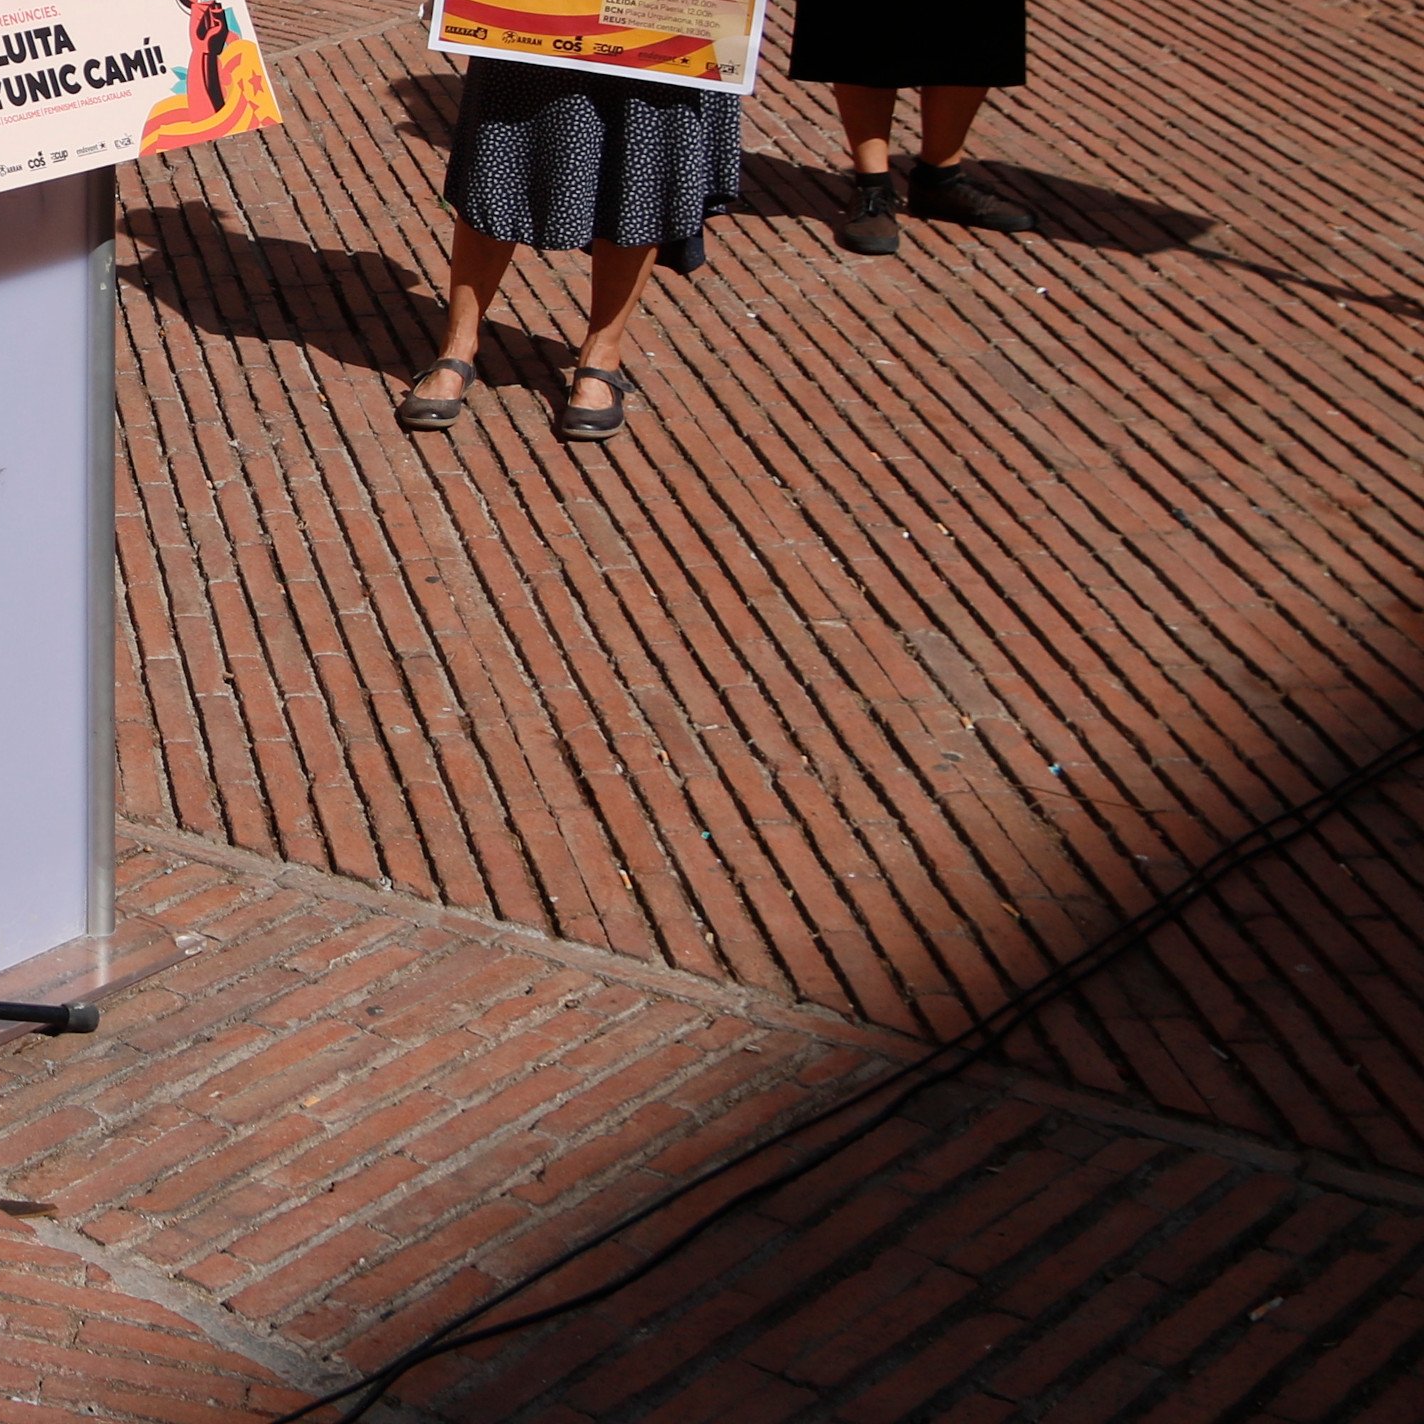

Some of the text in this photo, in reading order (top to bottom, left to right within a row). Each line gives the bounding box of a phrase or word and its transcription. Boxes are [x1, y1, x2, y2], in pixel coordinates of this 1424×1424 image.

[83, 36, 167, 89] CAMÍ!
[3, 109, 41, 125] SOCIALISME
[43, 101, 78, 116] FEMINISME
[102, 89, 133, 102] CATALANS
